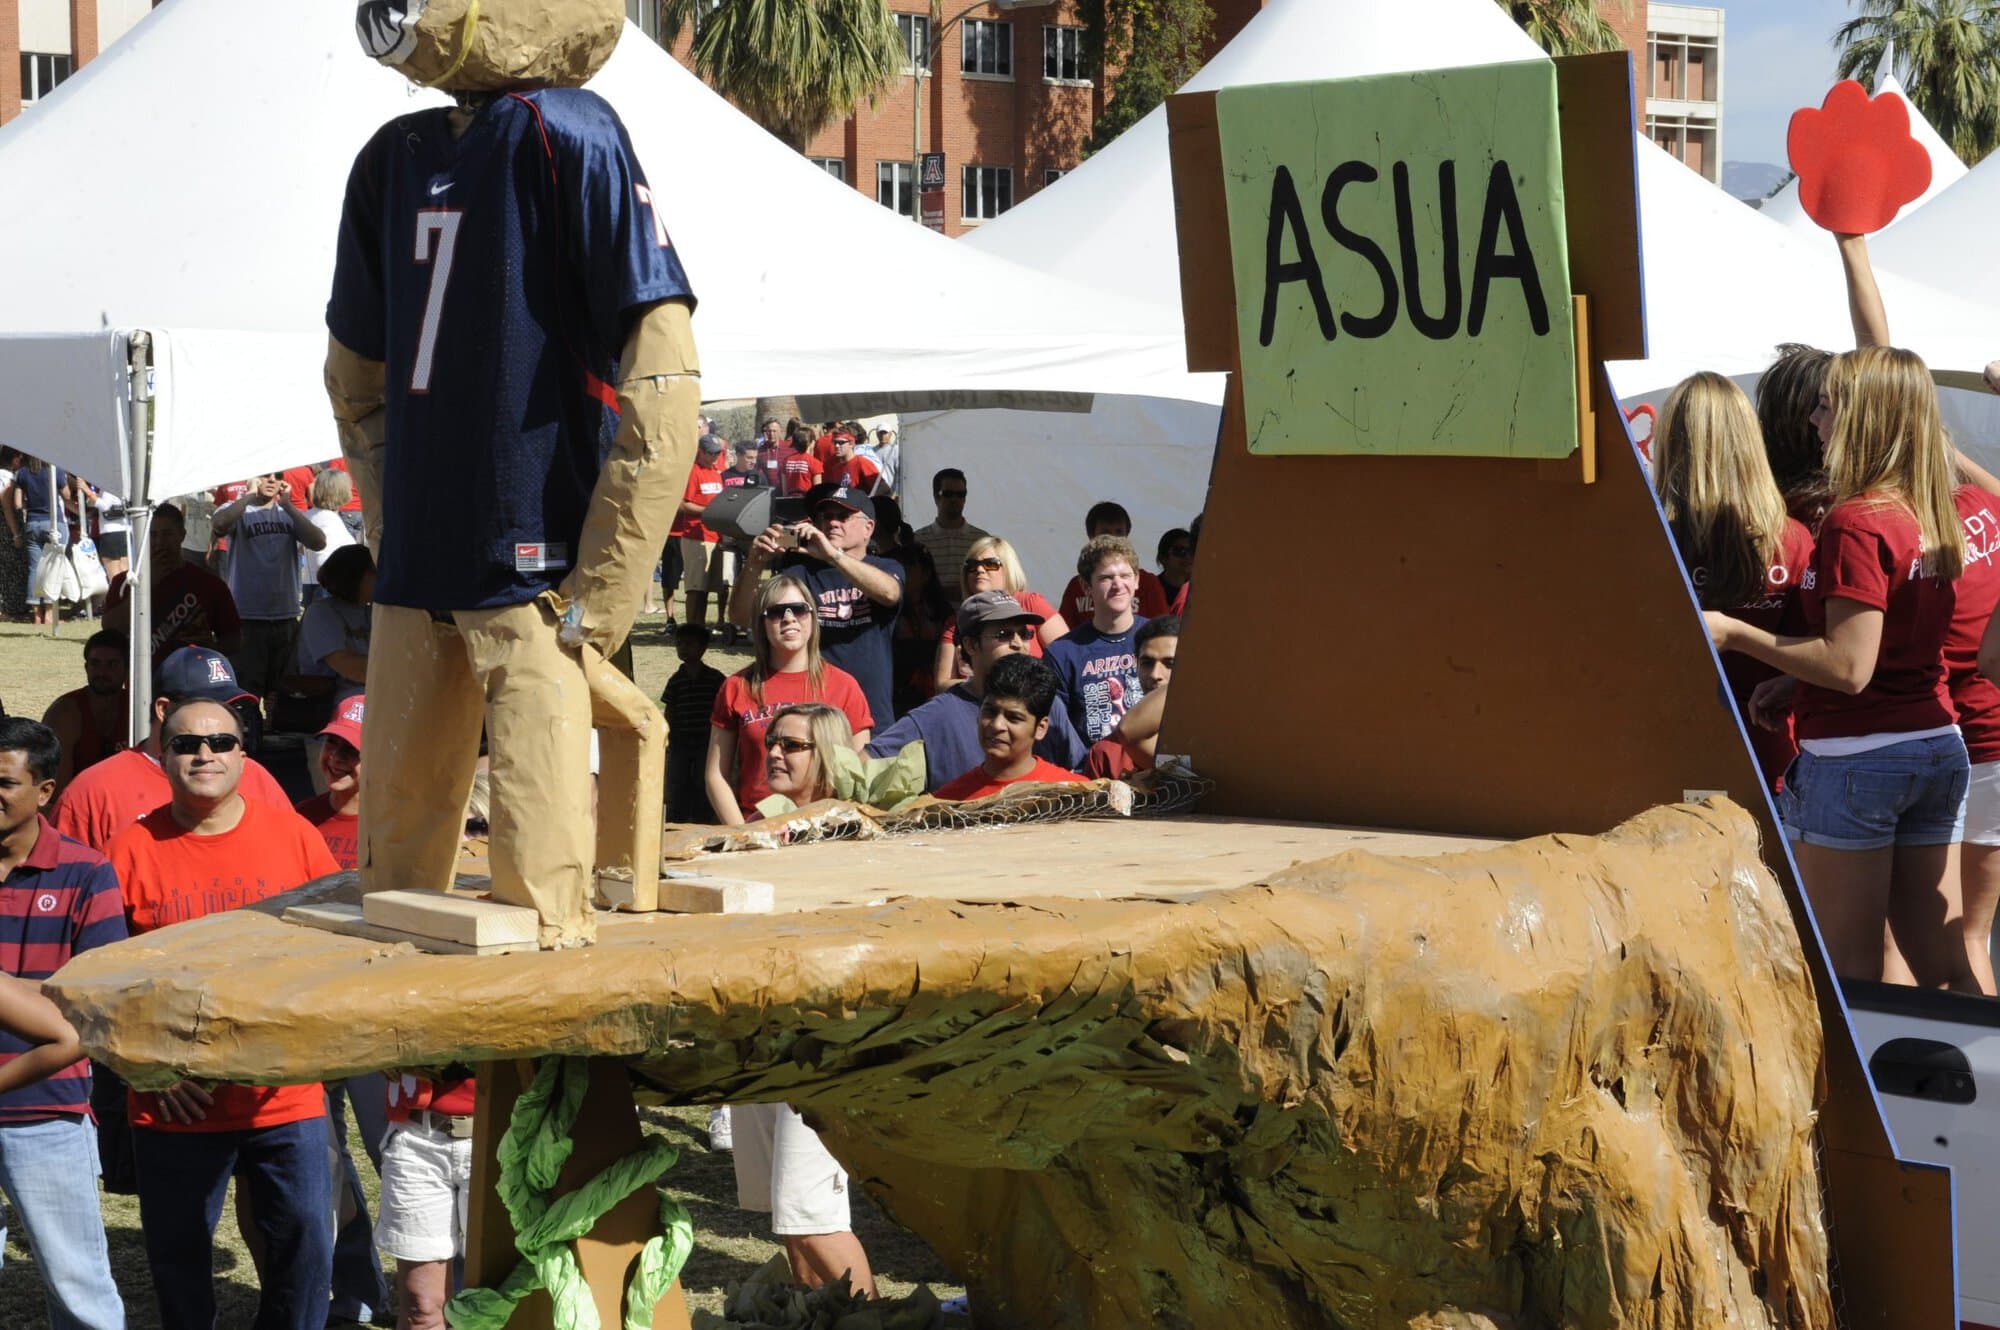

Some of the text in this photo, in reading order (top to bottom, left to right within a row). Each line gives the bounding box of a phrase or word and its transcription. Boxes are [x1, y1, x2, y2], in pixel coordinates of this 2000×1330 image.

[923, 155, 944, 183] A
[634, 183, 671, 247] 7
[1259, 159, 1549, 347] ASUA
[409, 207, 464, 393] 7
[207, 657, 233, 684] A
[1083, 682, 1100, 741] TENNIS
[1096, 680, 1112, 724] CLUB
